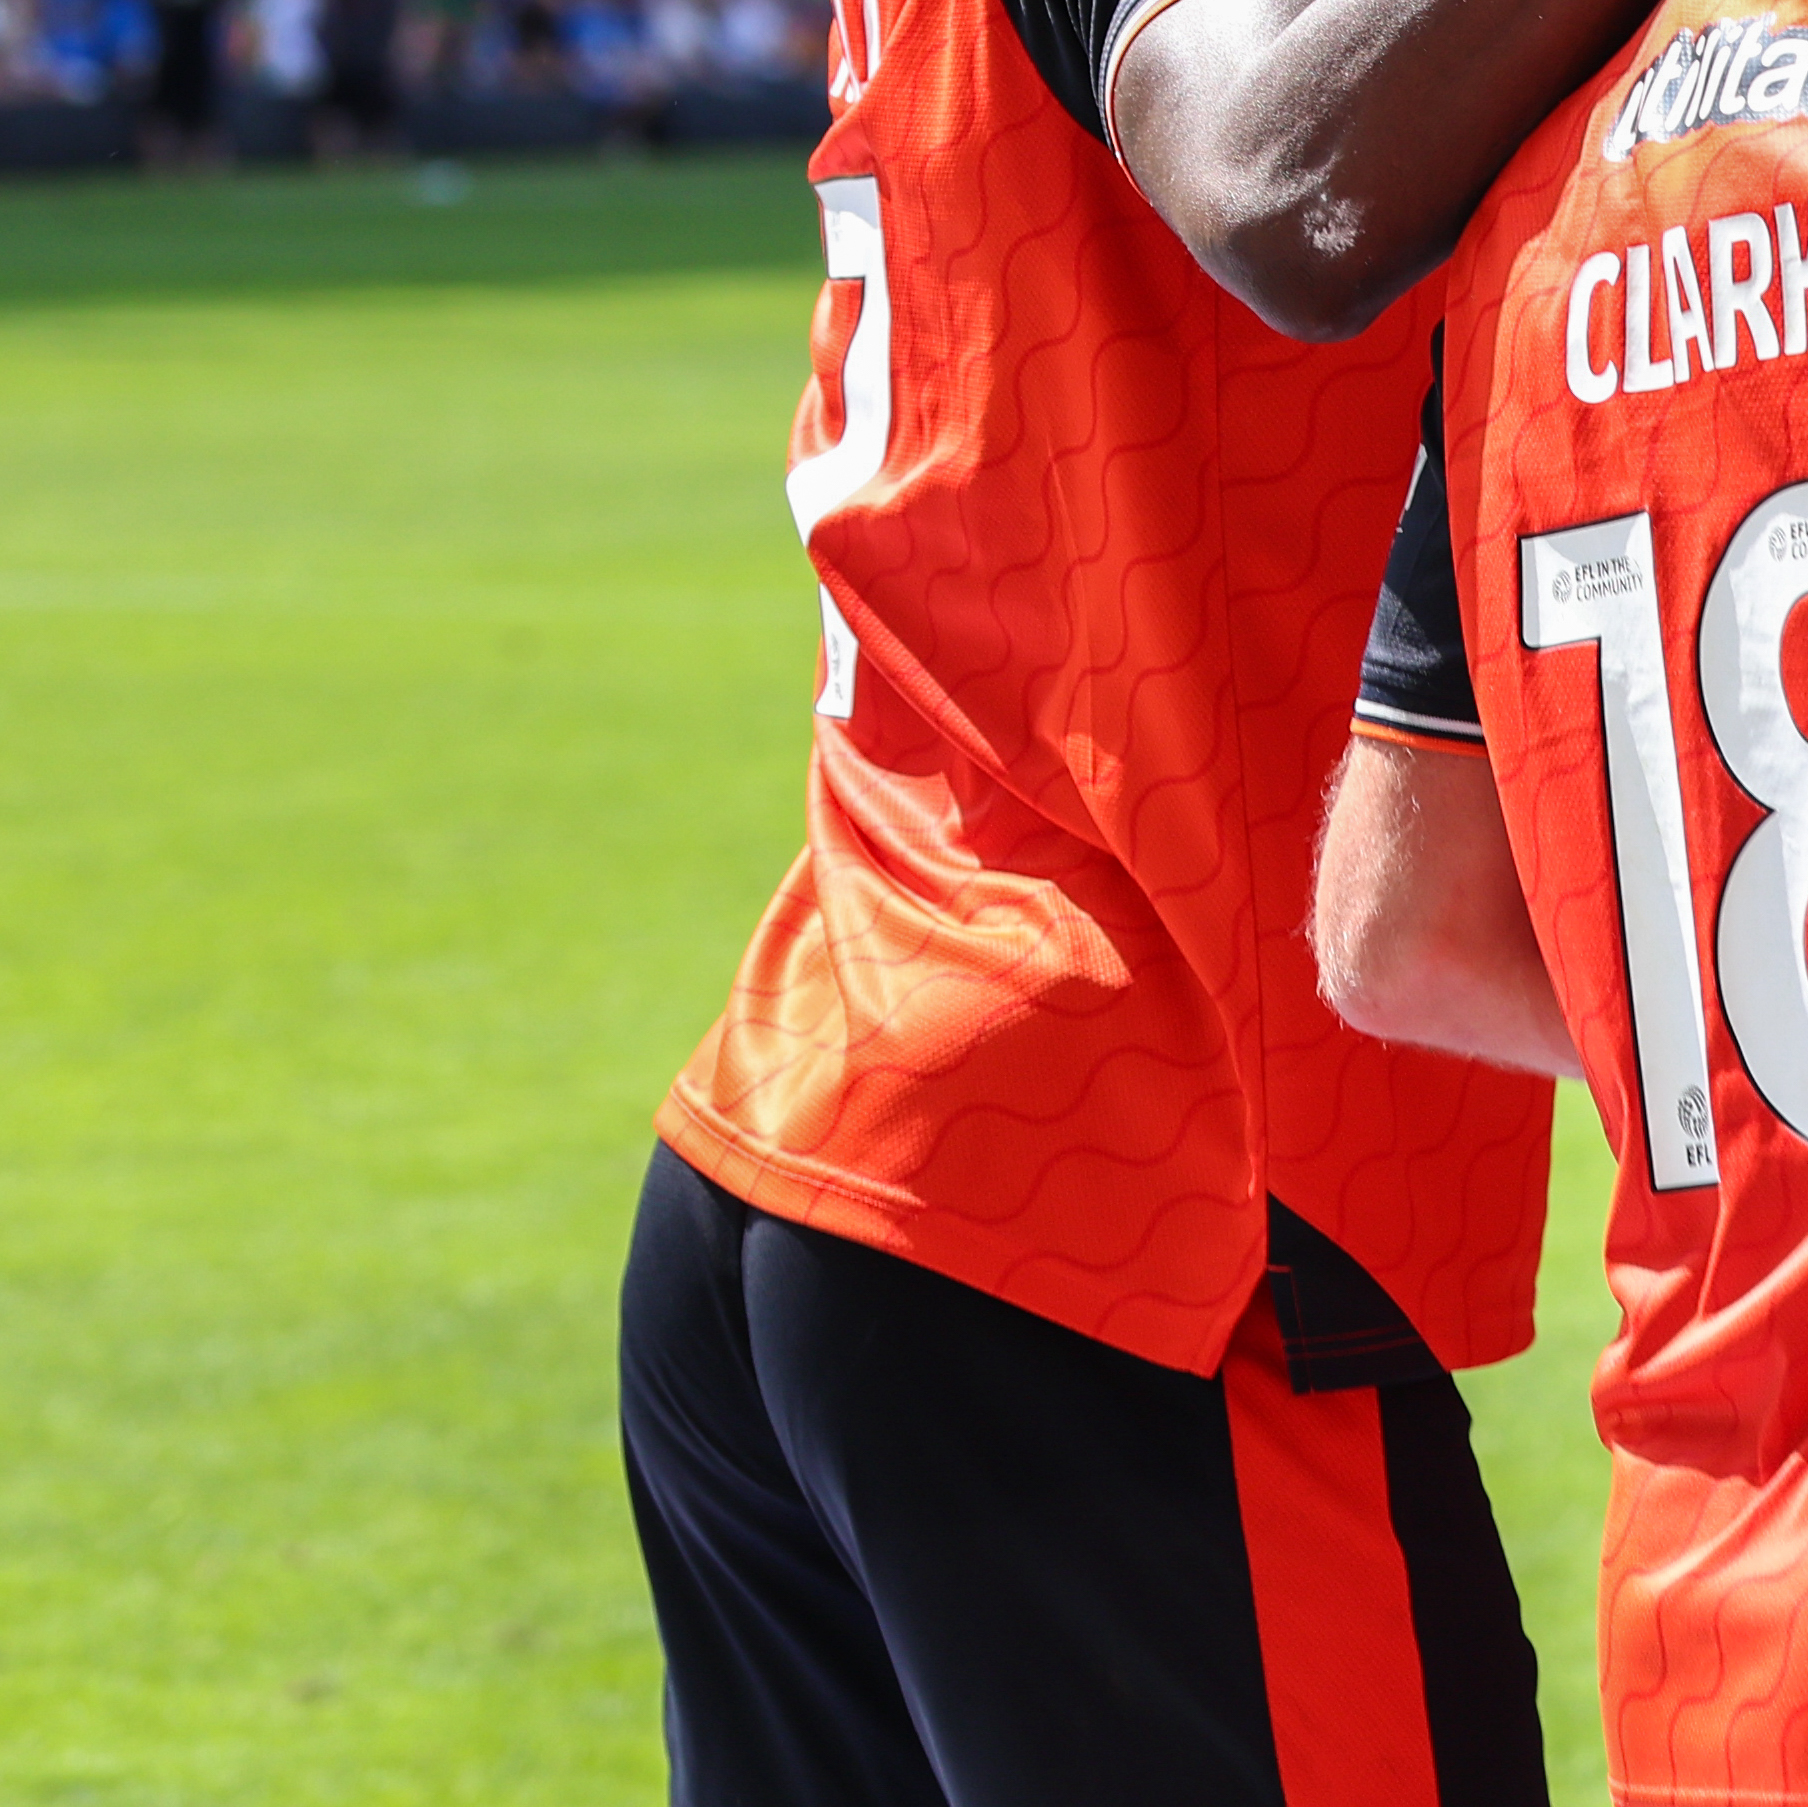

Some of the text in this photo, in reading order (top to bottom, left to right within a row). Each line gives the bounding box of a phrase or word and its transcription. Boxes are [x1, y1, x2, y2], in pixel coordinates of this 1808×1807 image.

[1575, 555, 1632, 583] EFL IN THE
[1576, 573, 1644, 602] COMMUNITY
[1686, 1144, 1713, 1168] EFL
